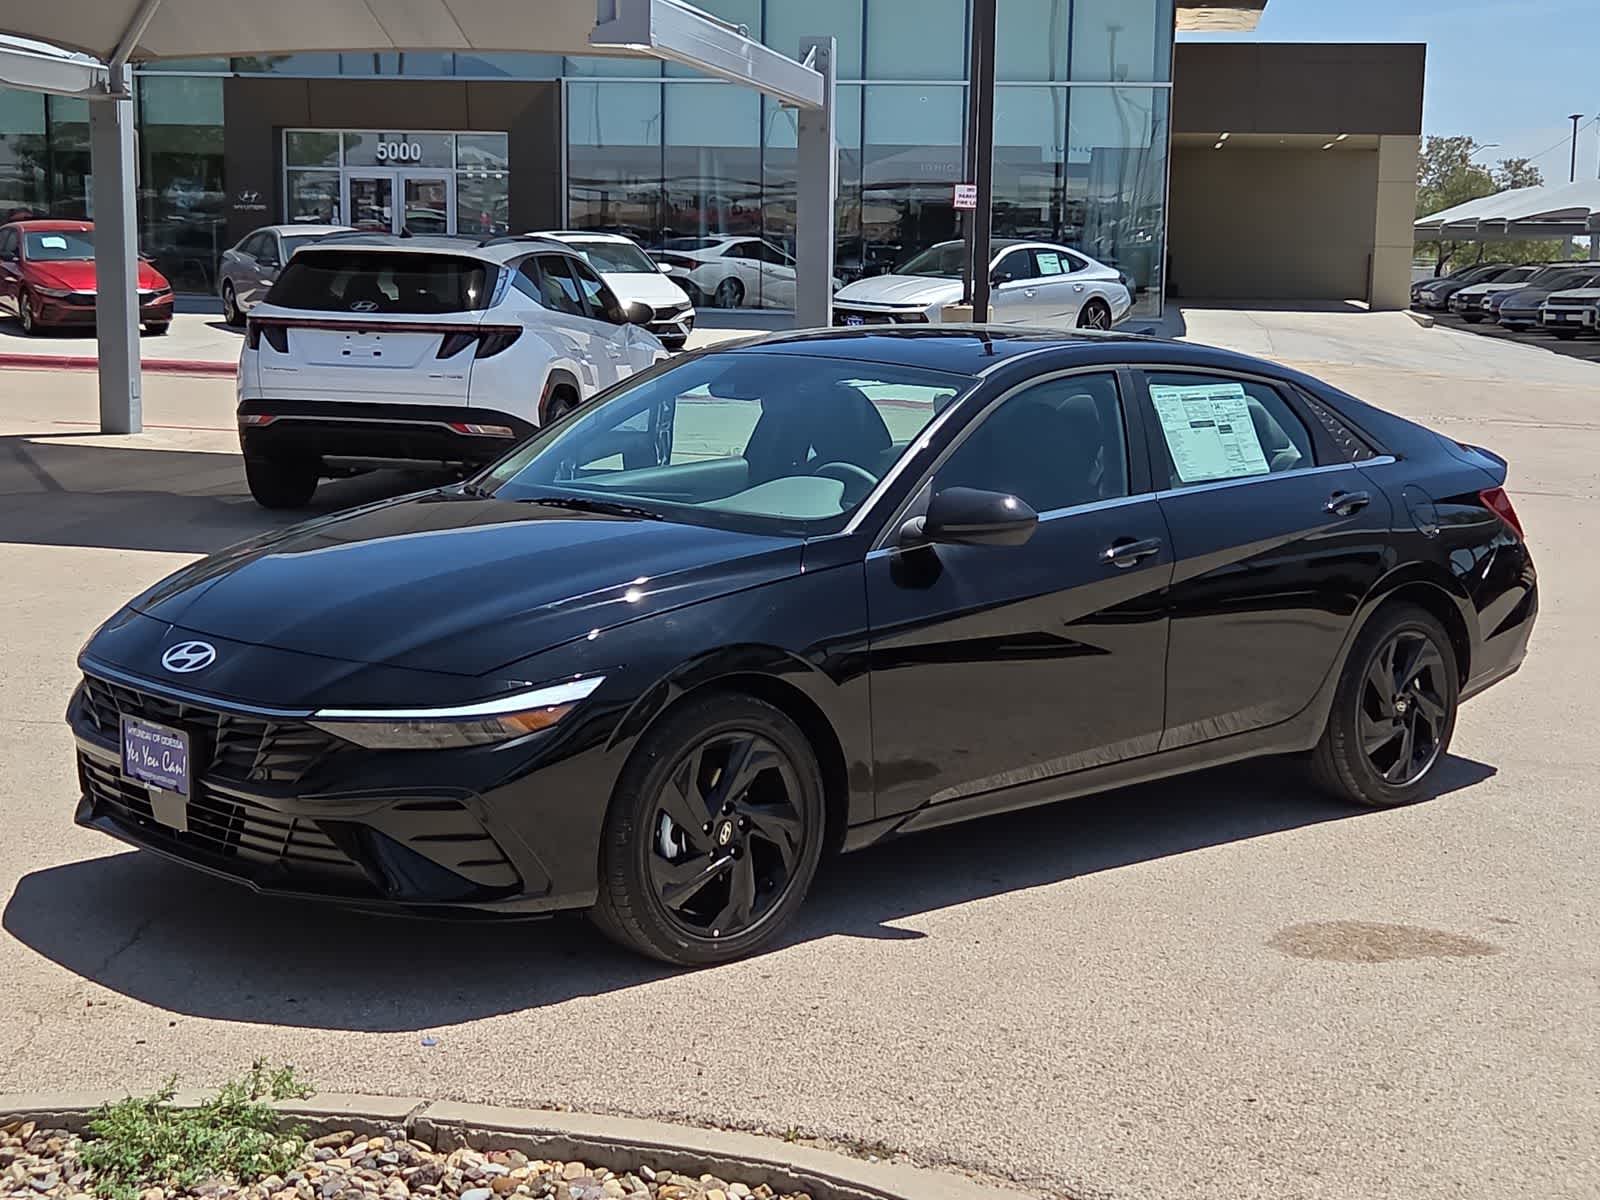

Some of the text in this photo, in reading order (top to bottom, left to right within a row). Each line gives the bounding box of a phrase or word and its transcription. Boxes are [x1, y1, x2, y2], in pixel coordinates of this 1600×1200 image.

[376, 142, 421, 160] 5000
[126, 739, 139, 763] Yes
[142, 745, 159, 768] You
[162, 751, 186, 777] Can!
